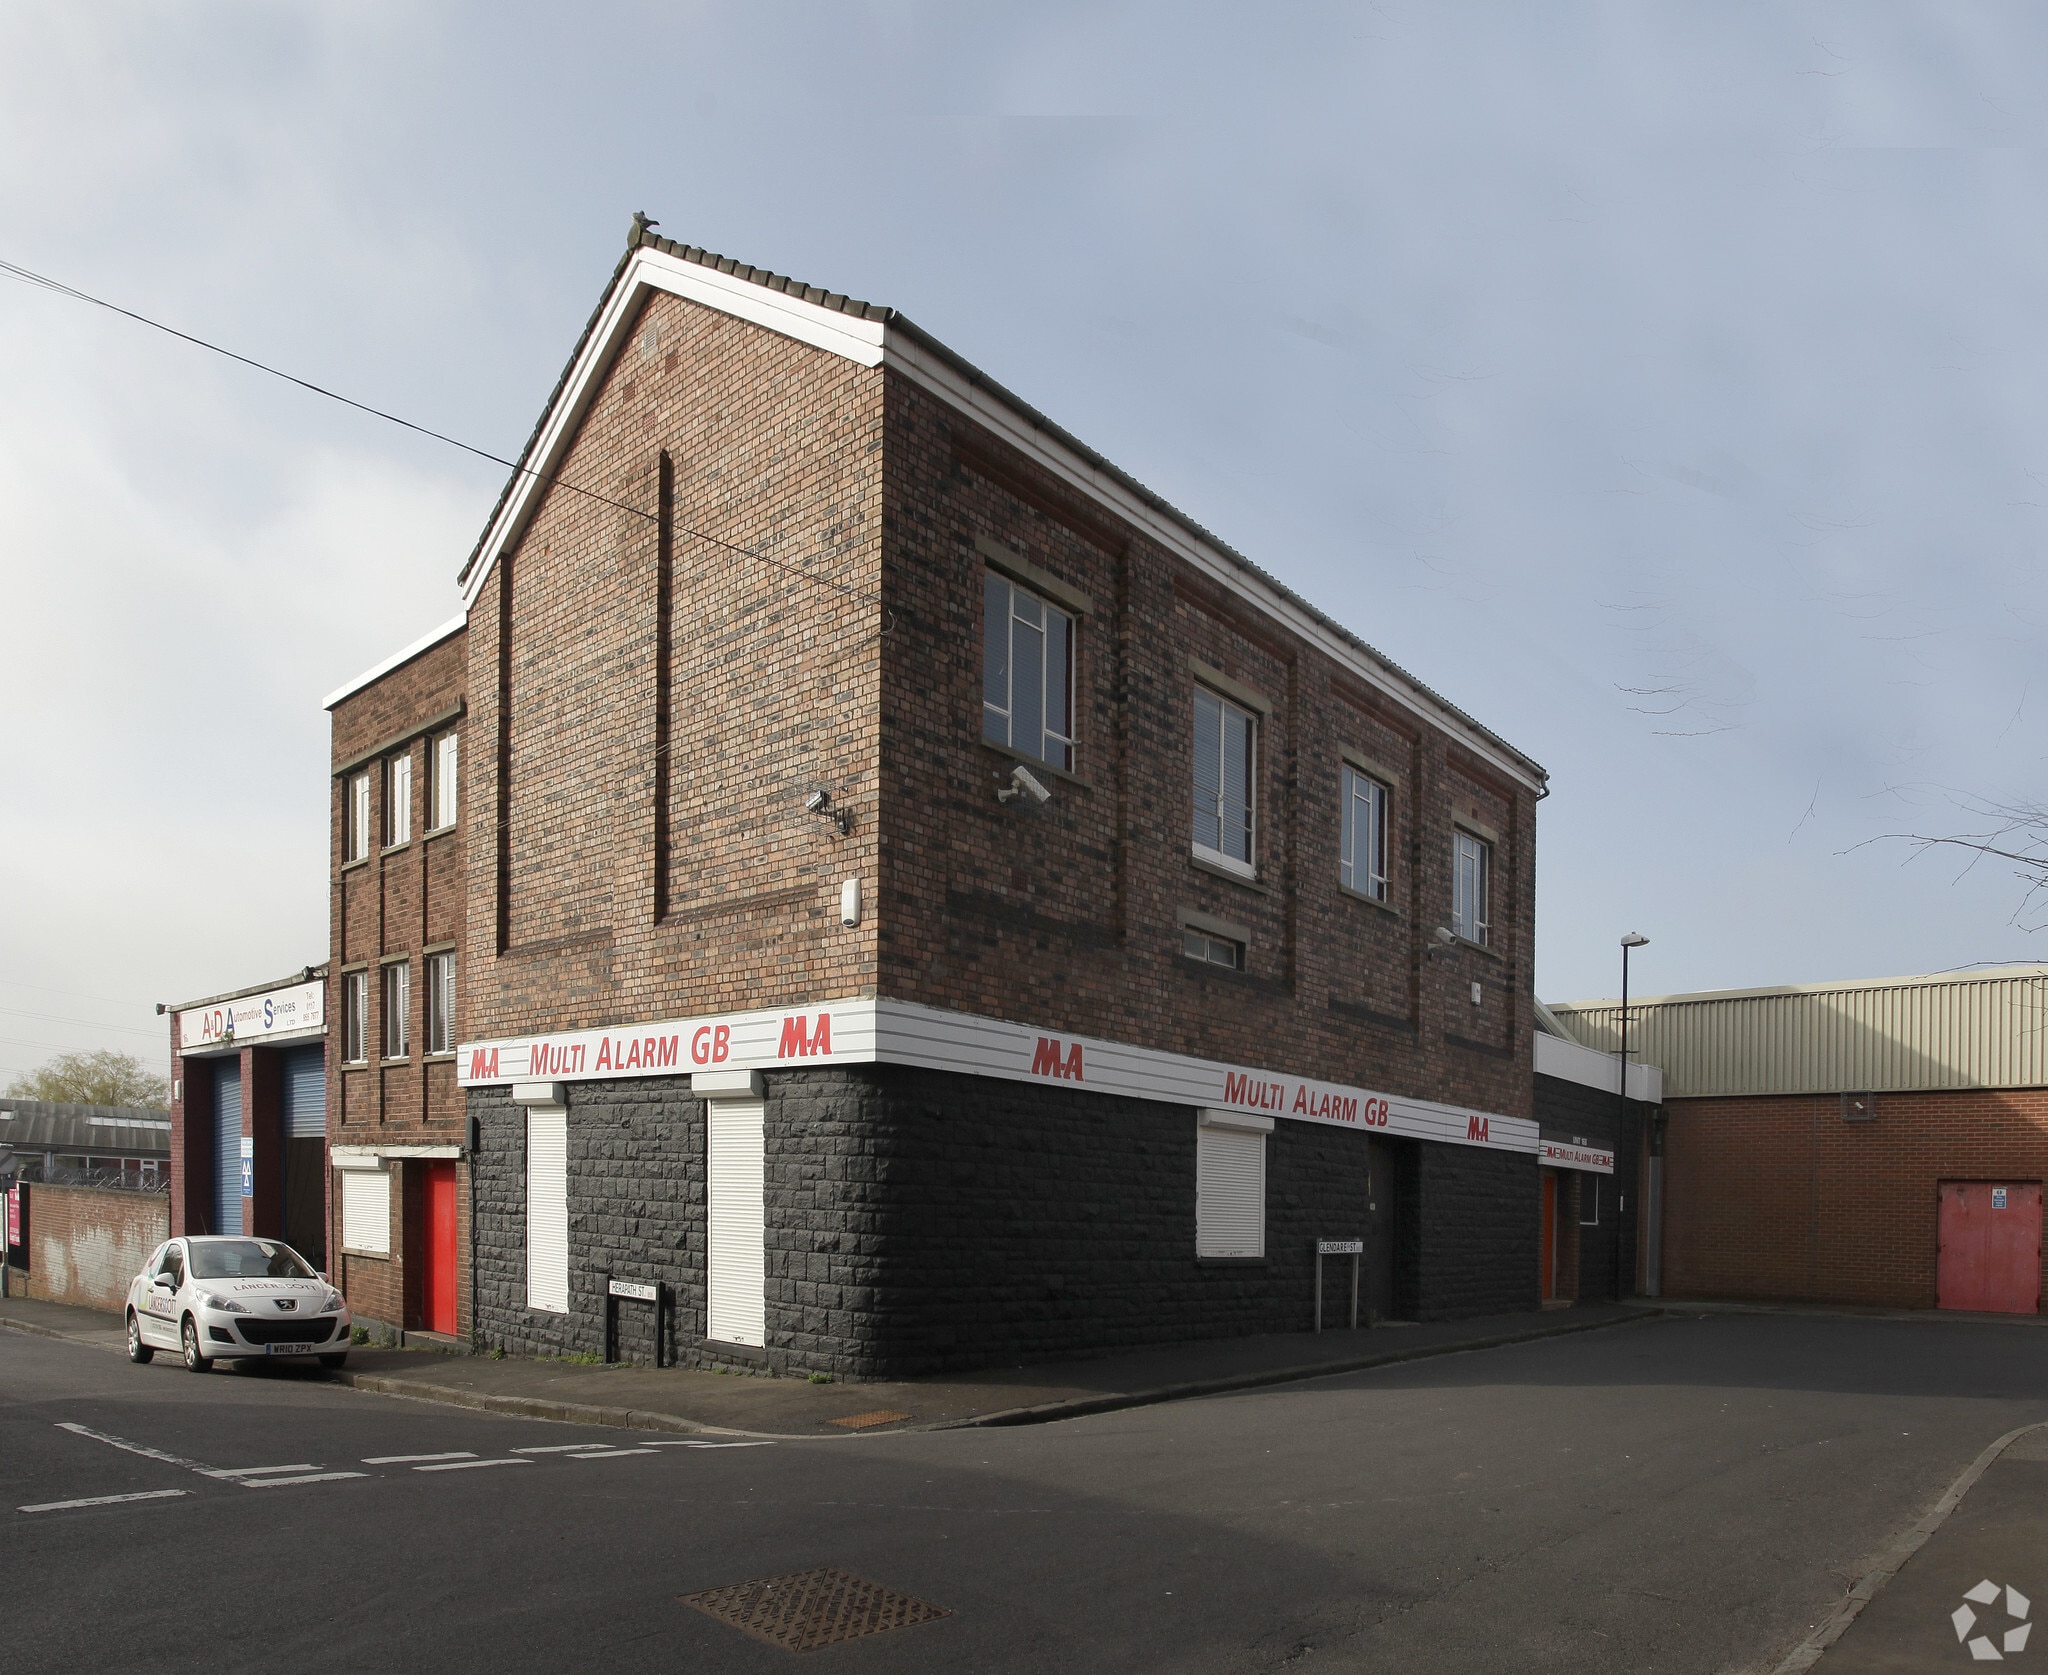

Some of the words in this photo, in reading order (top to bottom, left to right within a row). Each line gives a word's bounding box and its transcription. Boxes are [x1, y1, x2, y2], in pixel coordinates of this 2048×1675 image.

[226, 1007, 263, 1034] Automotive
[264, 999, 296, 1029] Services
[529, 1043, 587, 1076] MULTI
[595, 1035, 679, 1071] ALARM
[691, 1025, 730, 1065] GB
[1223, 1071, 1284, 1110] MULTI
[1293, 1085, 1357, 1122] ALARM
[1364, 1098, 1388, 1126] GB
[295, 1344, 312, 1353] ZPX
